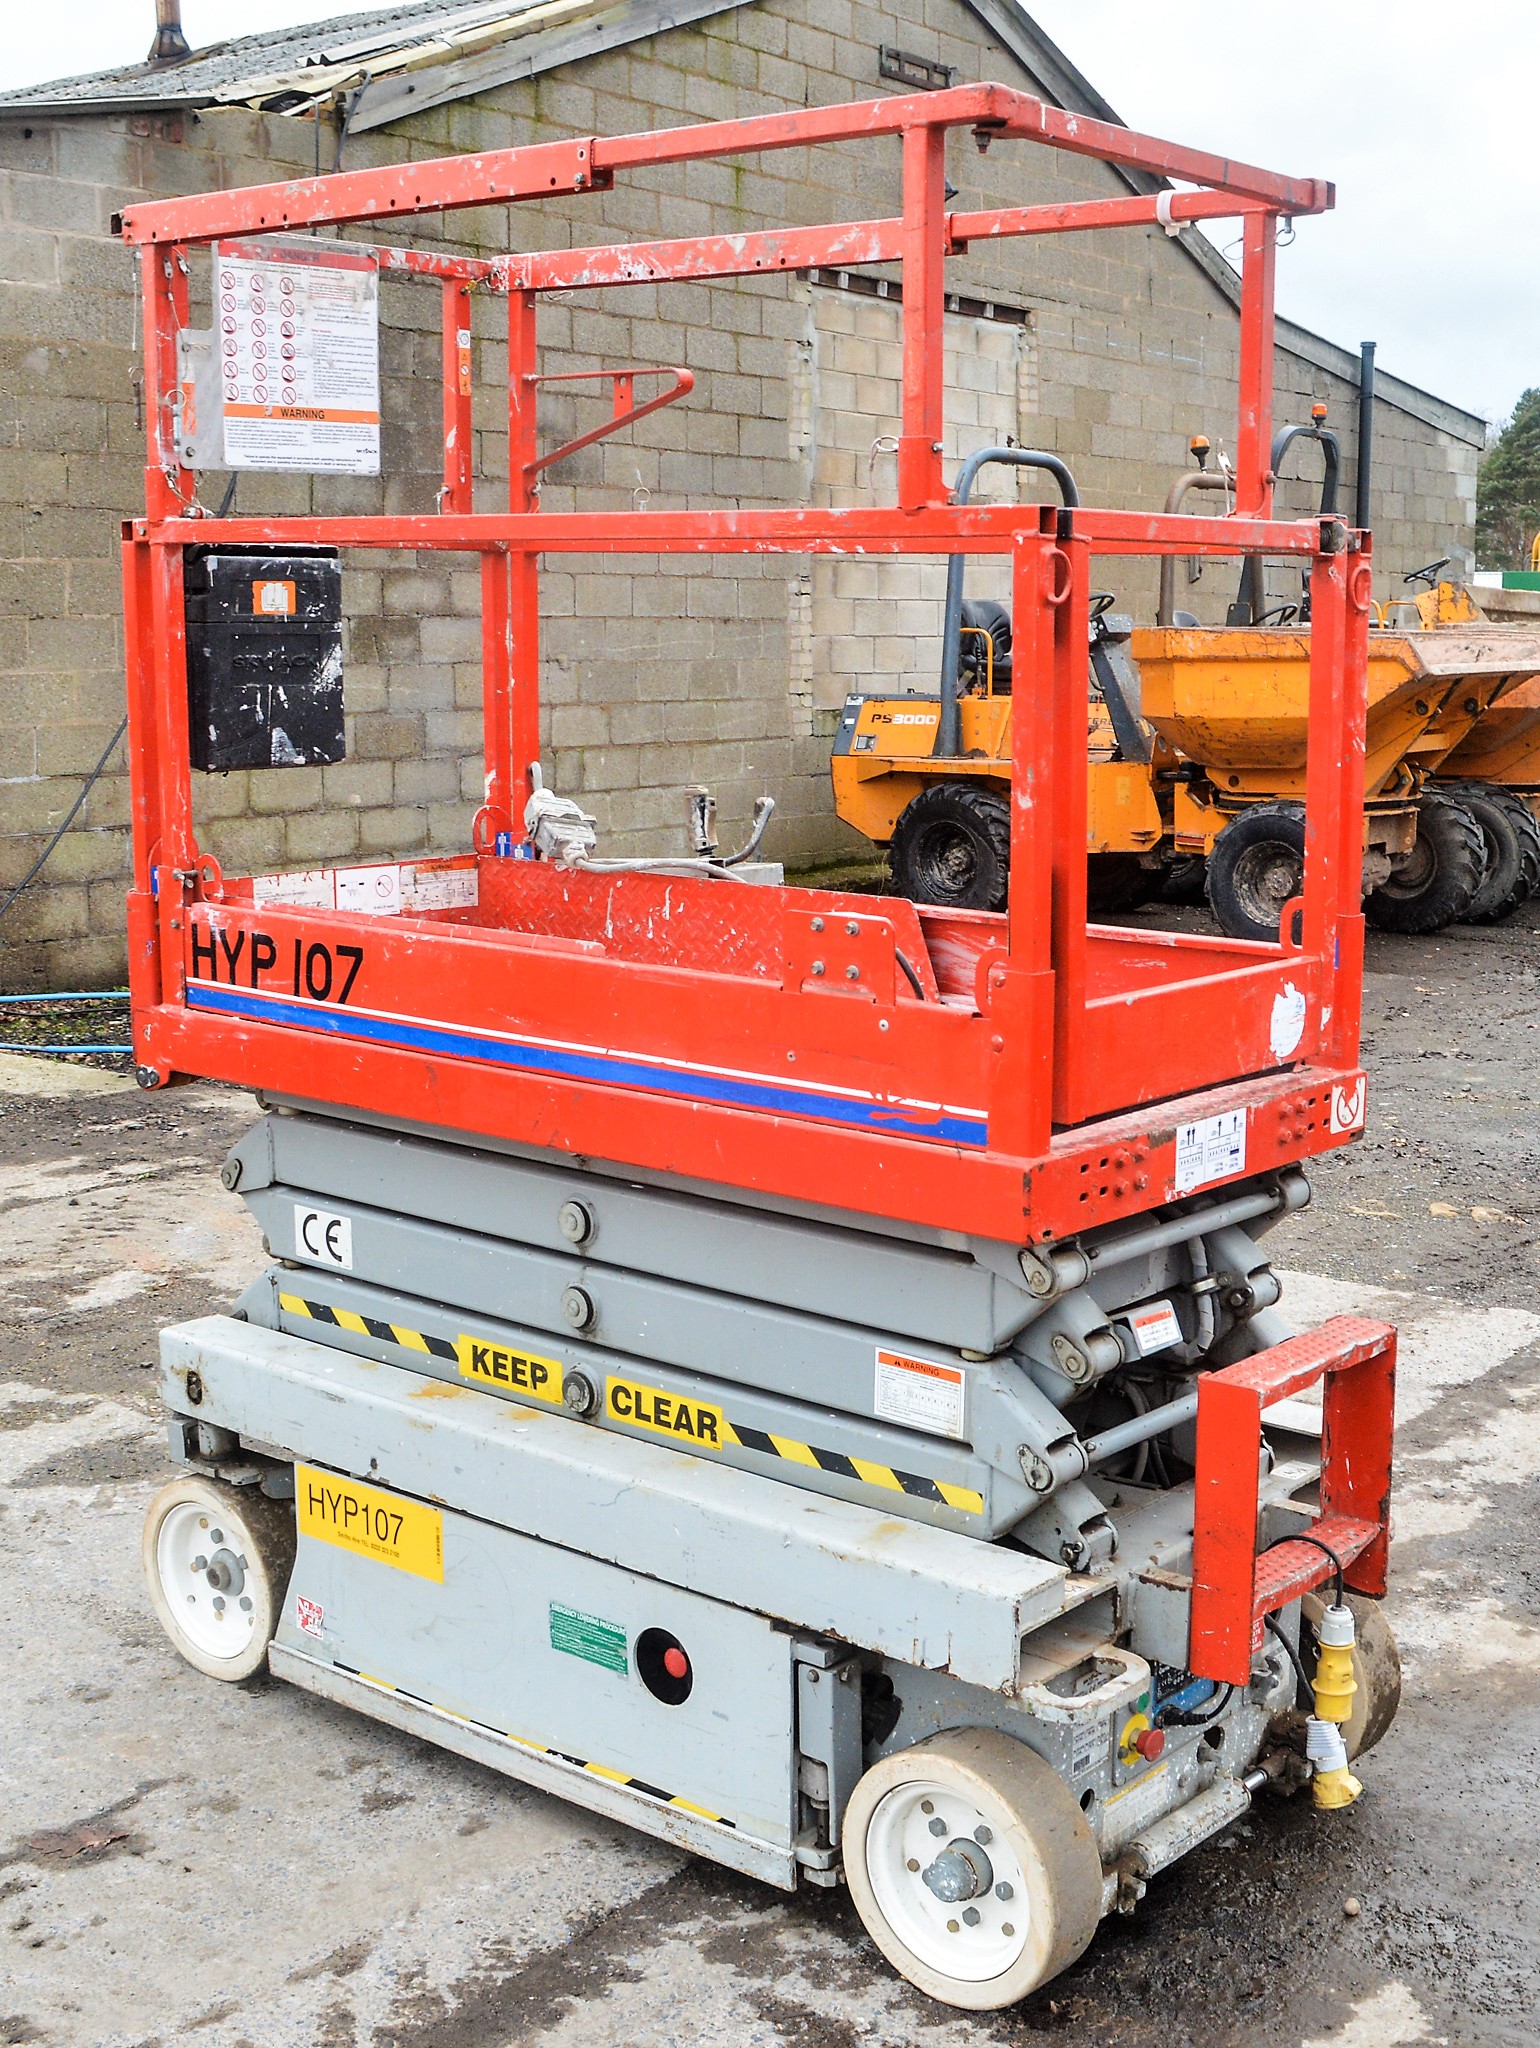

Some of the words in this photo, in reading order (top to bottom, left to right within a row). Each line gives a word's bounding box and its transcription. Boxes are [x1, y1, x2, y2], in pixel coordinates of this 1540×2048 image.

[280, 408, 325, 420] WARNING
[871, 713, 937, 725] PS3000
[191, 923, 277, 989] HYP
[293, 938, 364, 1004] 107
[302, 1213, 343, 1262] CE
[472, 1344, 549, 1391] KEEP
[902, 1360, 940, 1376] WARNING
[611, 1385, 719, 1443] CLEAR
[308, 1483, 404, 1545] HYP107
